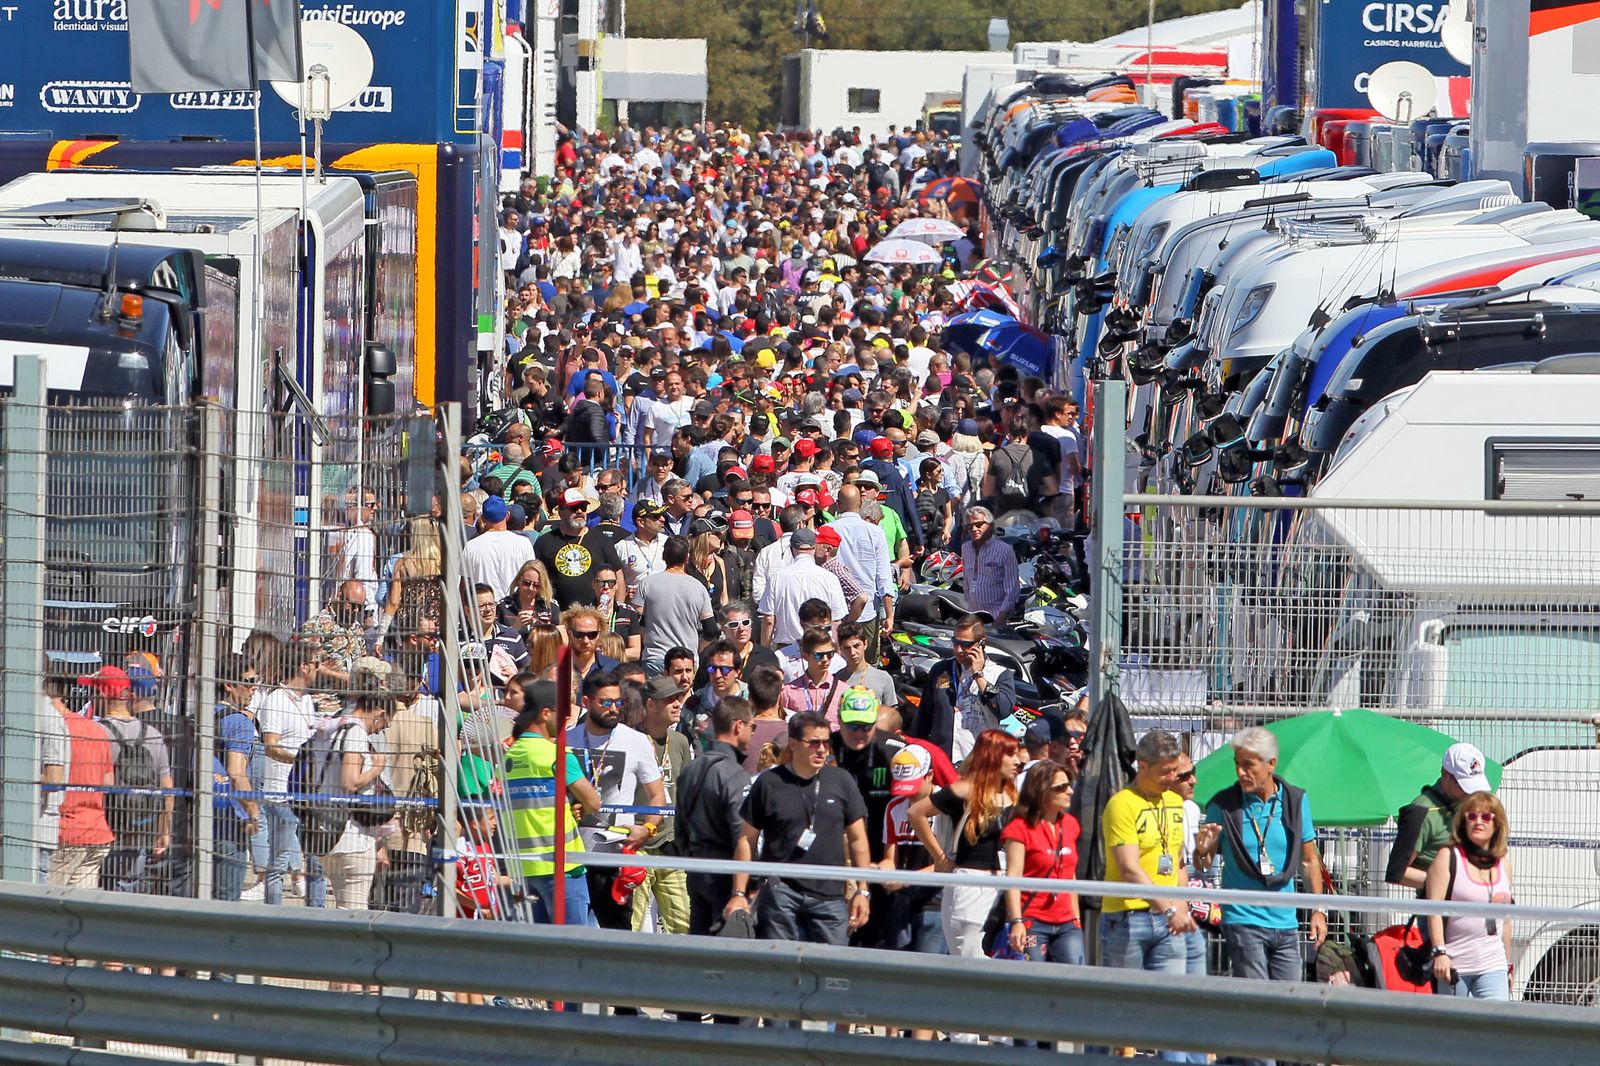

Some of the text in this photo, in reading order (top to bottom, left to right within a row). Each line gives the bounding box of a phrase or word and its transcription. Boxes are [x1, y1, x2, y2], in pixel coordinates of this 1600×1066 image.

[300, 4, 406, 30] roisiEurope
[53, 21, 128, 31] Identidad visual
[1364, 39, 1399, 48] CASINOS
[51, 89, 130, 106] WANTY
[350, 90, 385, 108] UL
[1010, 353, 1040, 373] SUZUKI
